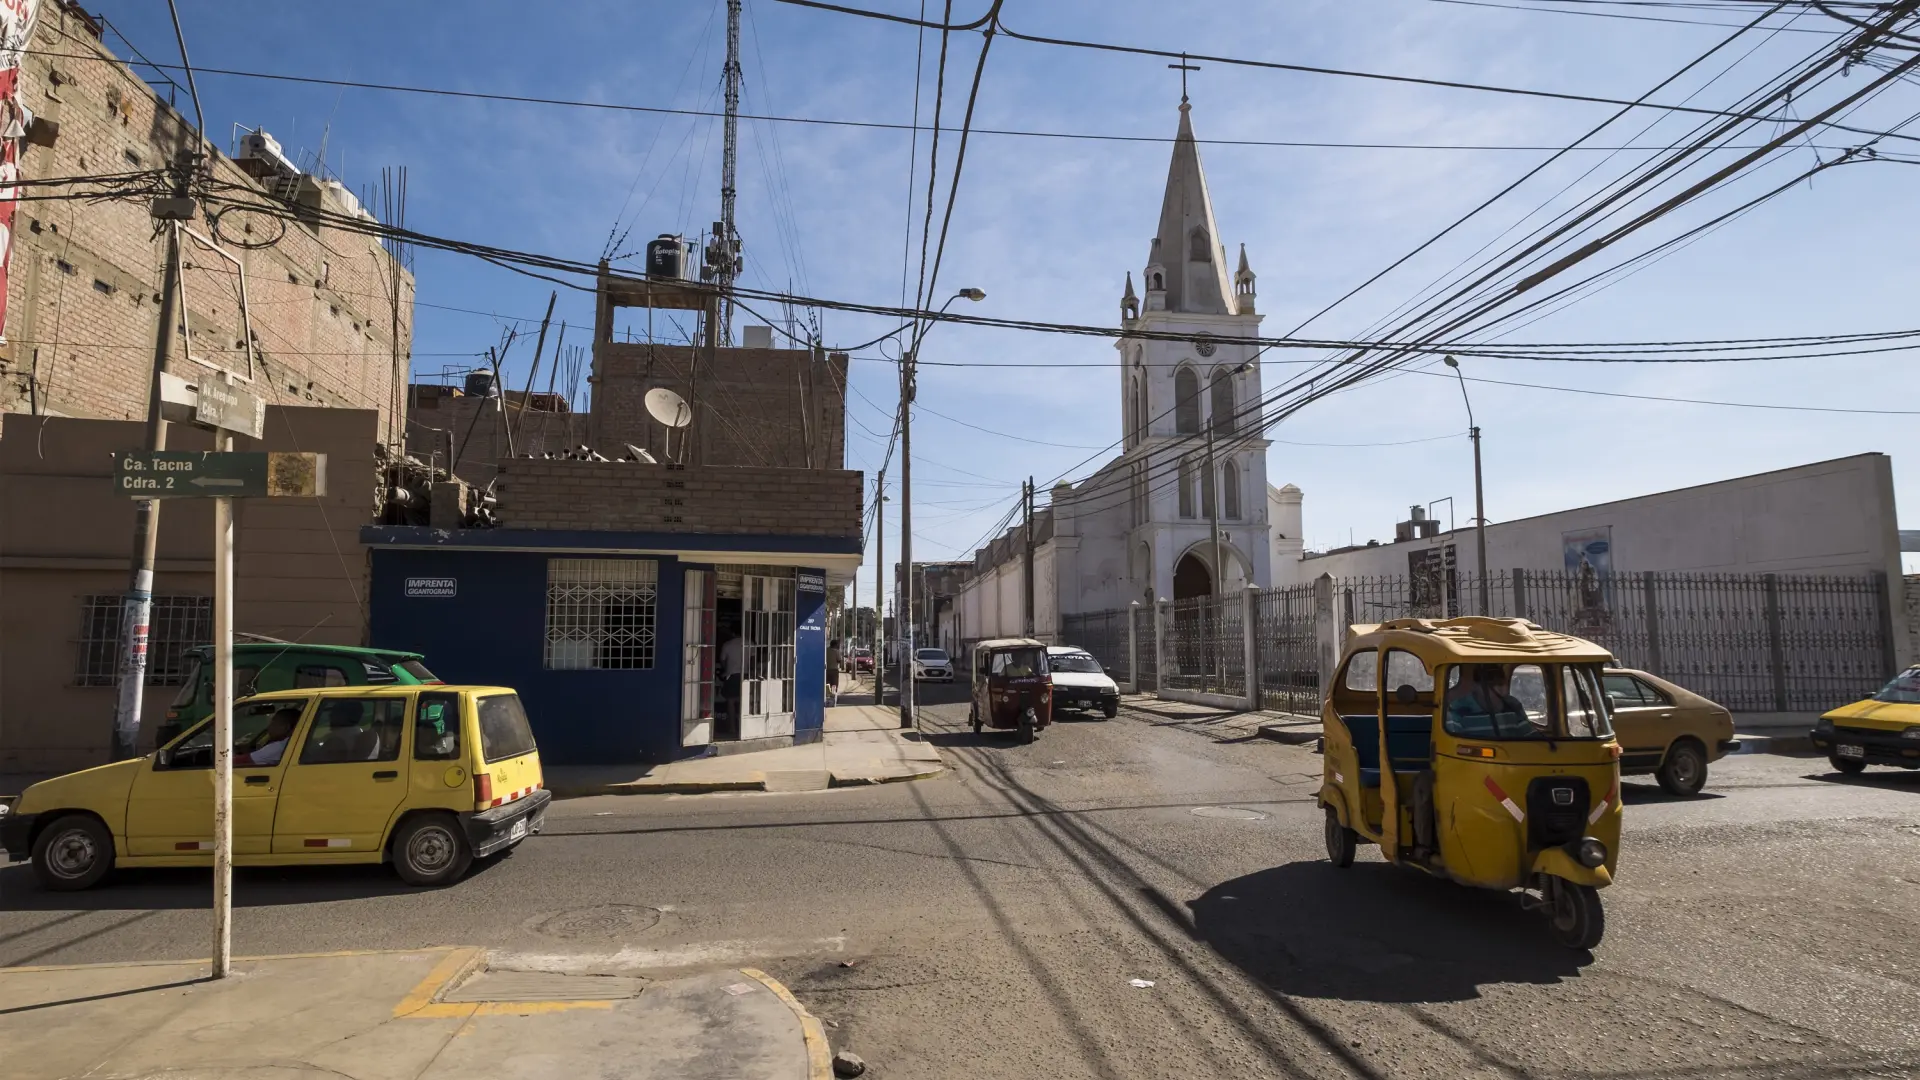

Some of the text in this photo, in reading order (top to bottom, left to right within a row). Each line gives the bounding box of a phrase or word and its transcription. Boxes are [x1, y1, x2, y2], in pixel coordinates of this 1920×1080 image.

[213, 387, 238, 407] Arequipa
[123, 458, 193, 471] Ca. Tacna
[123, 476, 175, 489] Cdra. 2
[408, 579, 454, 588] IMPRENTA
[799, 575, 823, 585] IMPRENTA
